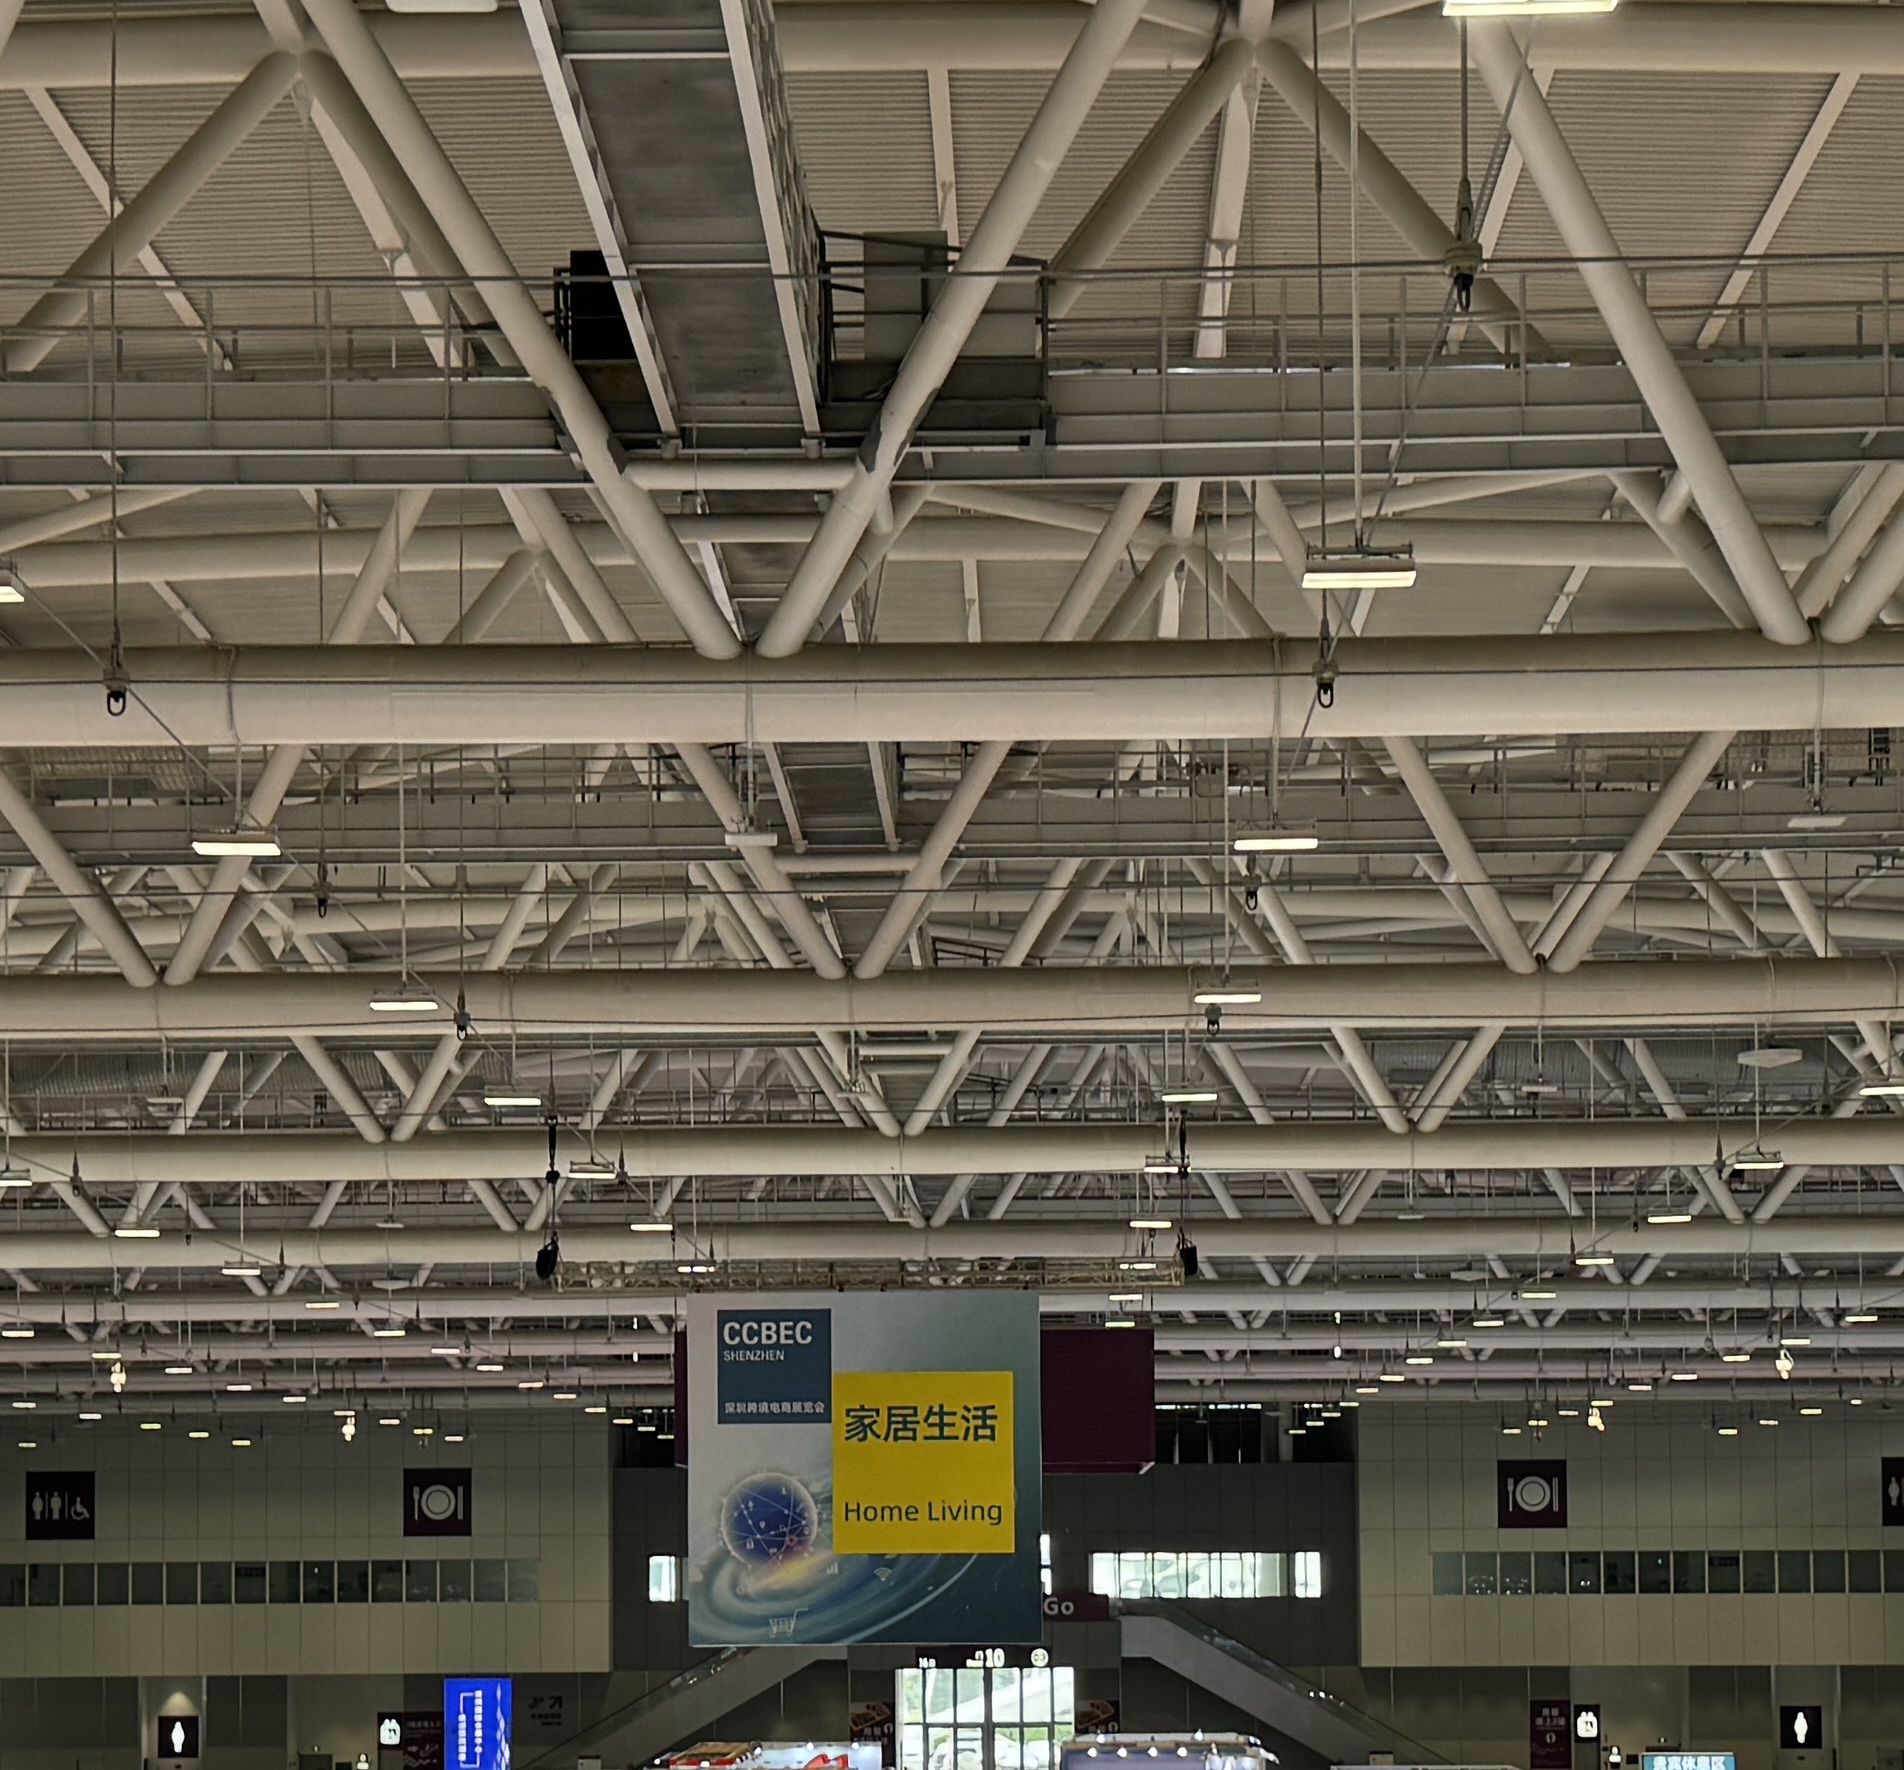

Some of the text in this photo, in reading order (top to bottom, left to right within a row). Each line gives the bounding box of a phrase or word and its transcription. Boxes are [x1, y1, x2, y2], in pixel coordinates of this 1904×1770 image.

[723, 1321, 813, 1345] CCBEC
[723, 1350, 785, 1361] SHENZHEN
[844, 1404, 999, 1442] 家居生活
[844, 1498, 1004, 1526] Home Living
